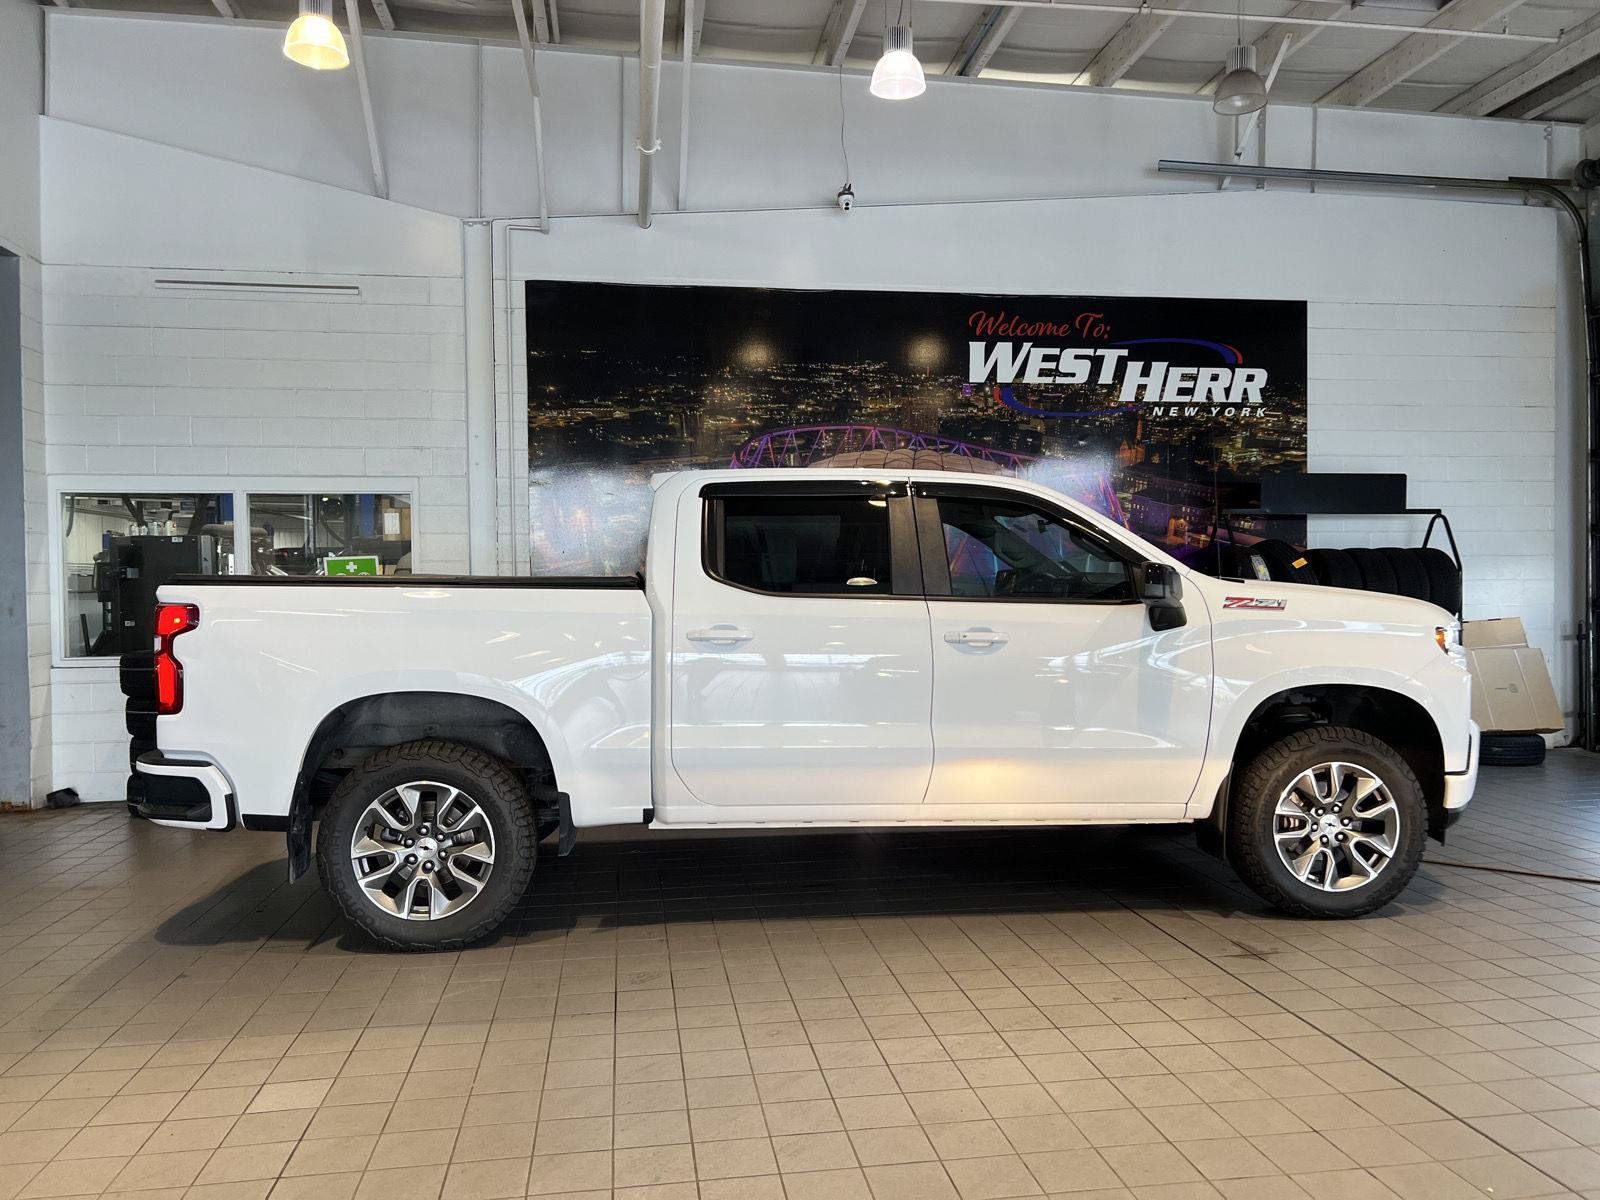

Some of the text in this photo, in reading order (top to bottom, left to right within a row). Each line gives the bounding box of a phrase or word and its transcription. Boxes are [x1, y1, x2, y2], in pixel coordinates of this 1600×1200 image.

[968, 310, 1111, 340] Welcome To:
[968, 341, 1268, 403] WEST HERR
[1152, 406, 1267, 417] NEW YORK
